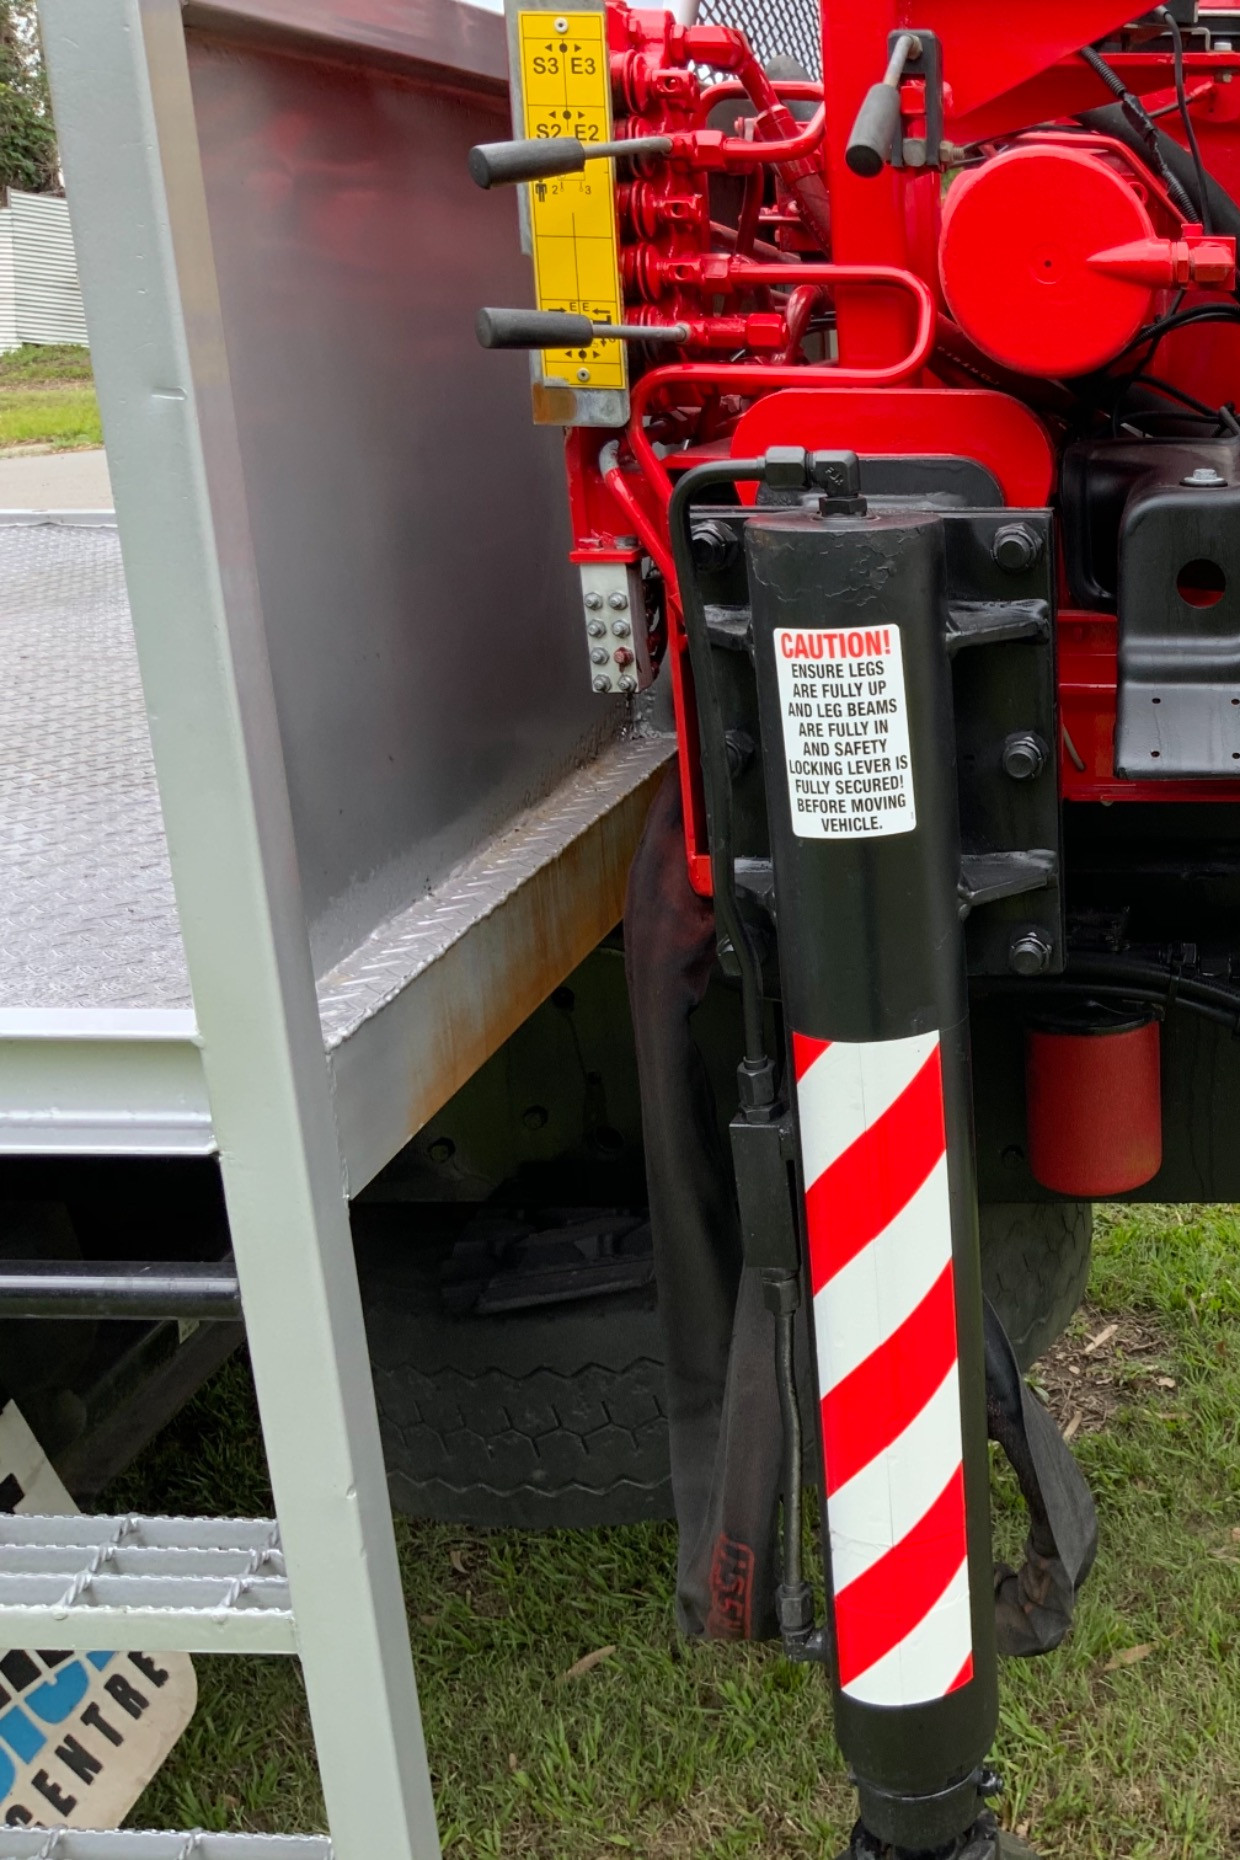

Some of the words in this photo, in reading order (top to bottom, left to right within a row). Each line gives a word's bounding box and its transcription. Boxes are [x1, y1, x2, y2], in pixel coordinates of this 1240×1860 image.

[533, 57, 559, 75] S3
[571, 57, 596, 75] E3
[574, 124, 600, 141] E2
[570, 302, 577, 311] E
[583, 303, 590, 311] E
[781, 629, 892, 659] CAUTION!
[791, 663, 845, 679] ENSURE
[849, 660, 885, 677] LEGS
[793, 683, 818, 698] ARE
[822, 682, 863, 698] FULLY
[868, 680, 886, 696] UP
[788, 703, 813, 717] AND
[817, 703, 842, 717] LEG
[848, 698, 898, 717] BEAMS
[799, 722, 823, 737] ARE
[828, 721, 869, 737] FULLY
[874, 719, 889, 734] IN
[803, 742, 830, 756] AND
[835, 738, 887, 757] SAFETY
[789, 759, 843, 776] LOCKING
[848, 757, 891, 775] LEVER
[896, 754, 909, 770] IS
[795, 779, 830, 795] FULLY
[835, 775, 904, 795] SECURED!
[797, 798, 847, 814] BEFORE
[851, 793, 907, 813] MOVING
[821, 816, 883, 832] VEHICLE.
